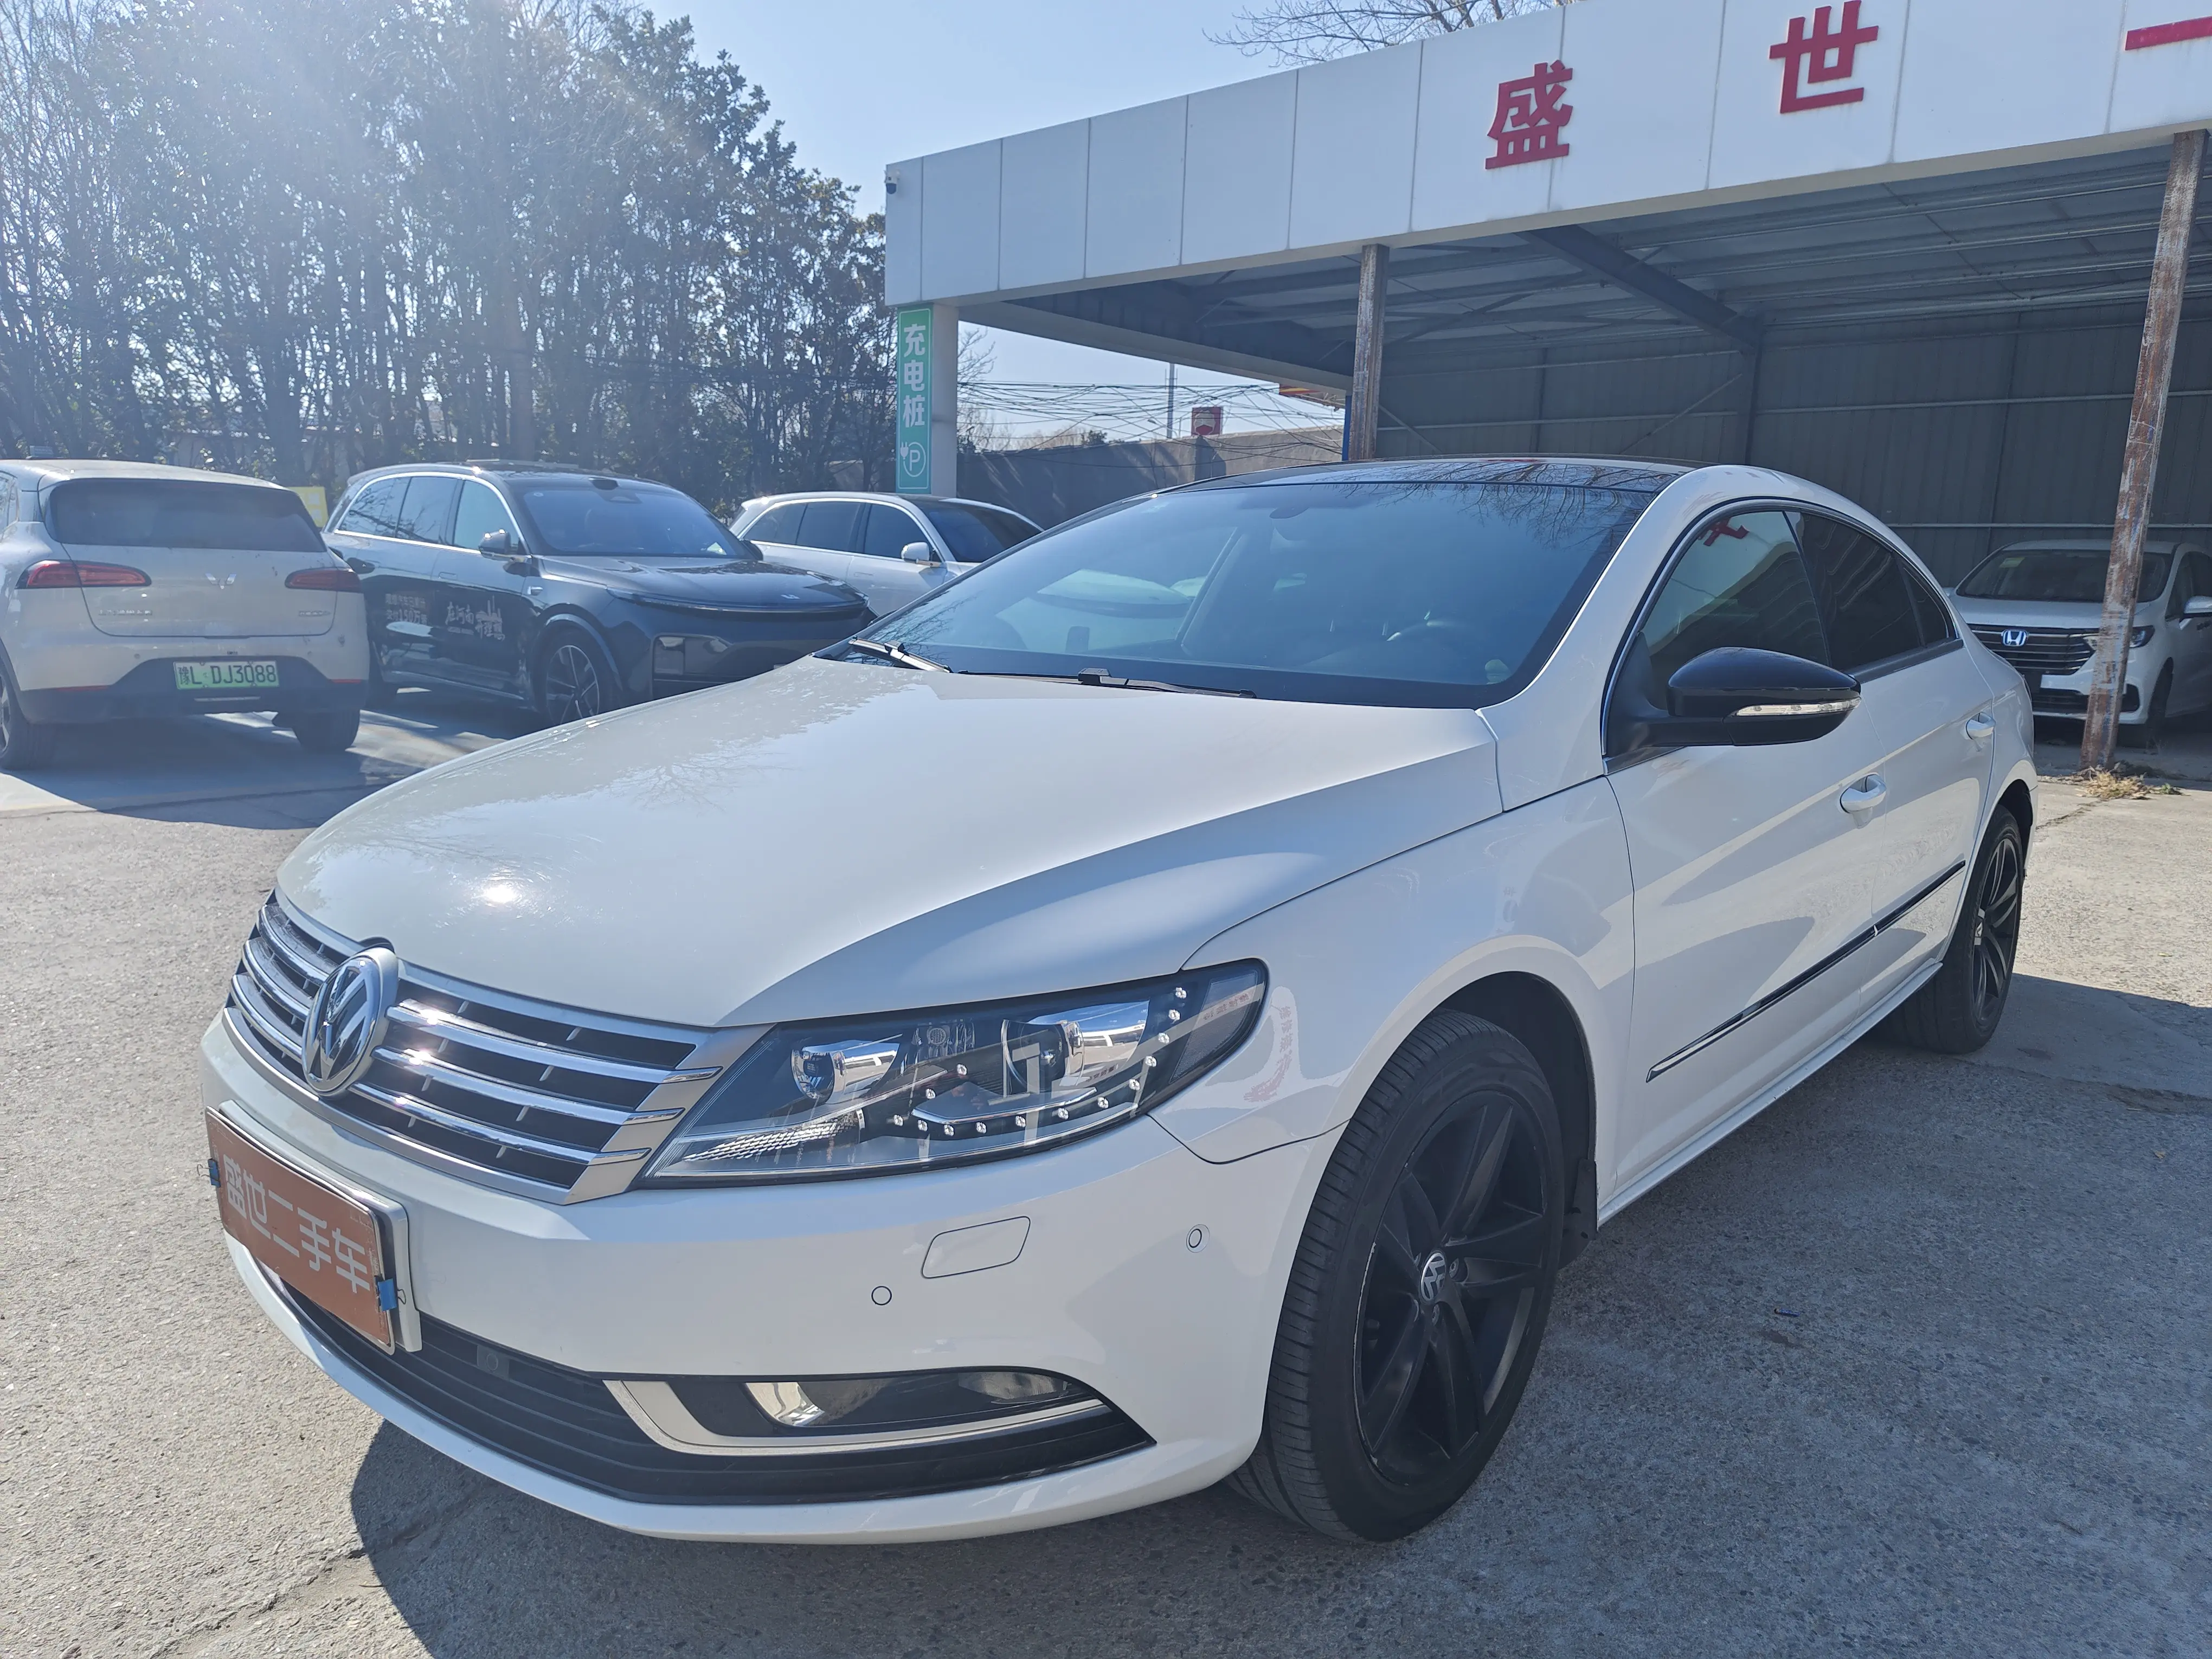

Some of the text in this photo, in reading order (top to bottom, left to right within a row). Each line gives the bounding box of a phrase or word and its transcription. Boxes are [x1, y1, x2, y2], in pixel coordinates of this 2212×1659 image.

[903, 324, 926, 428] 充电桩
[909, 449, 921, 471] P
[223, 1154, 371, 1294] 盛世二手车
